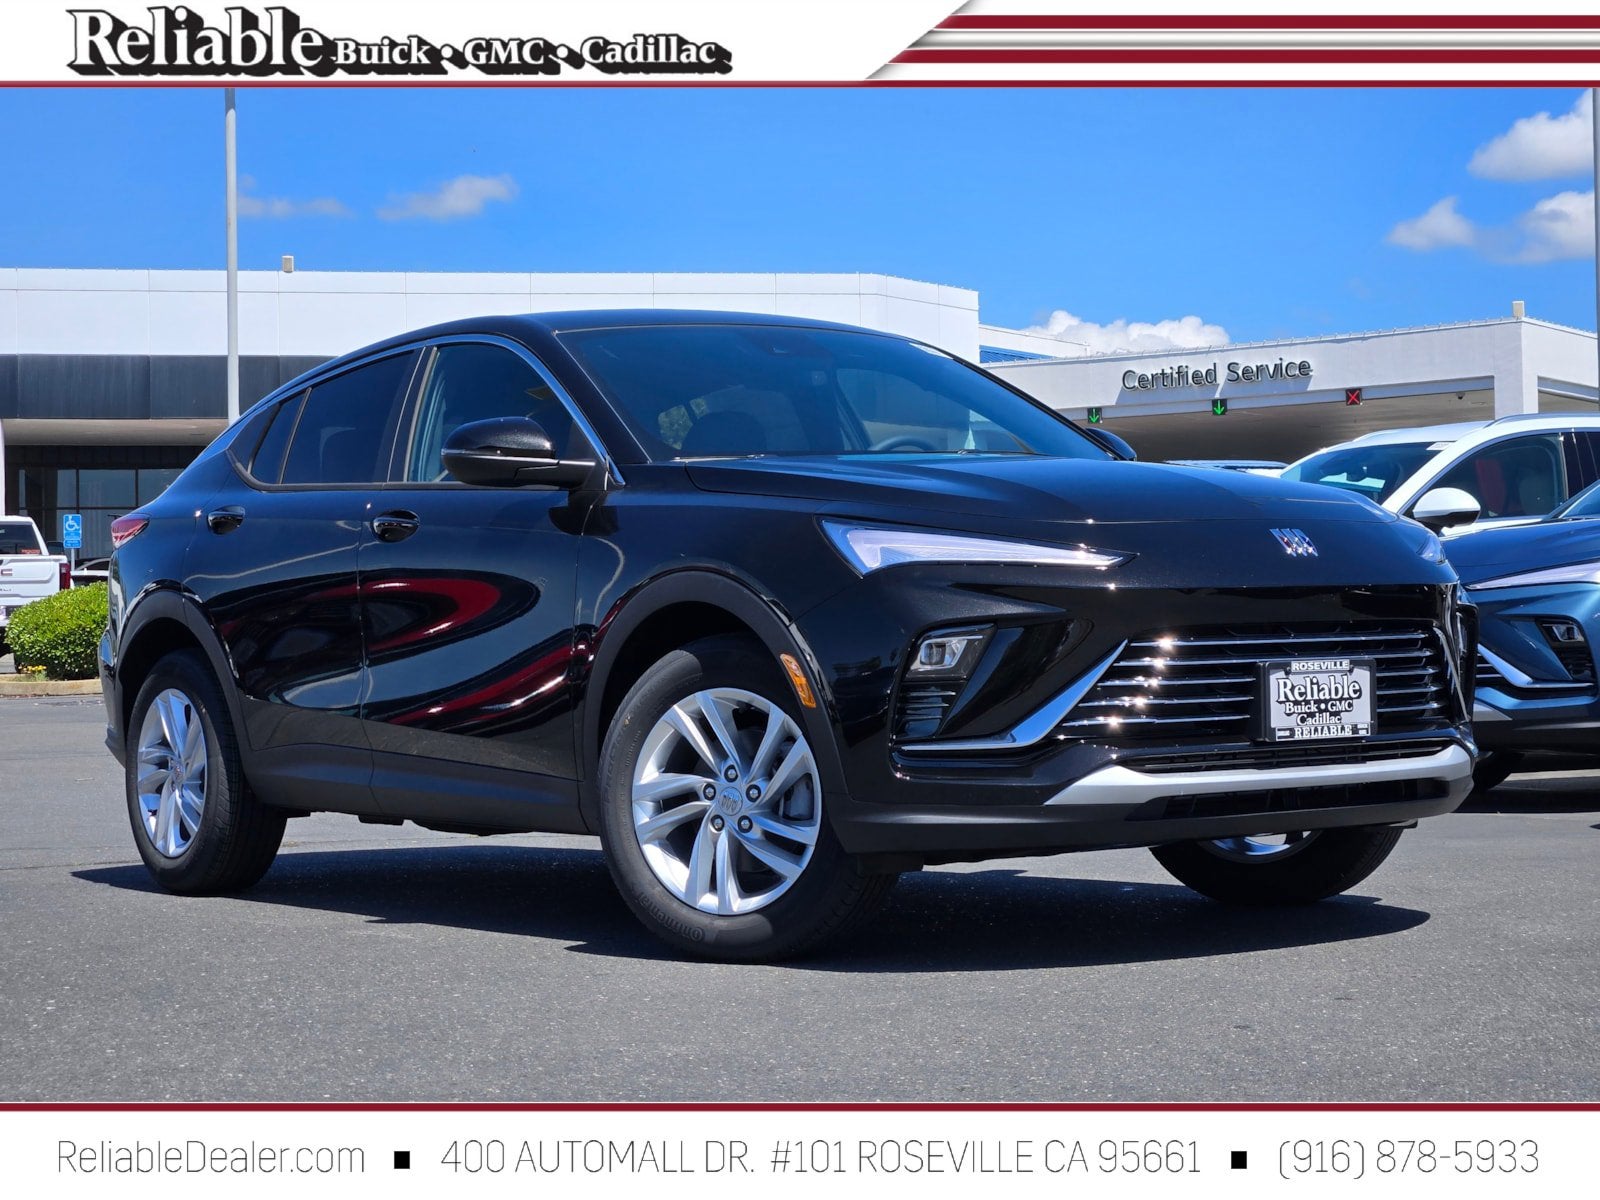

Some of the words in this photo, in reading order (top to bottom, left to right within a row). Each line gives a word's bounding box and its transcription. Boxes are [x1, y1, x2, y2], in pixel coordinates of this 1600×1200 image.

[1121, 362, 1218, 390] Certified
[1226, 358, 1313, 382] Service
[1292, 660, 1350, 671] ROSEVILLE
[1277, 675, 1361, 702] Reliable
[1285, 701, 1318, 714] Buick
[1327, 700, 1353, 712] GMC
[1297, 713, 1341, 725] Cadillac
[1294, 725, 1352, 738] RELIABLE
